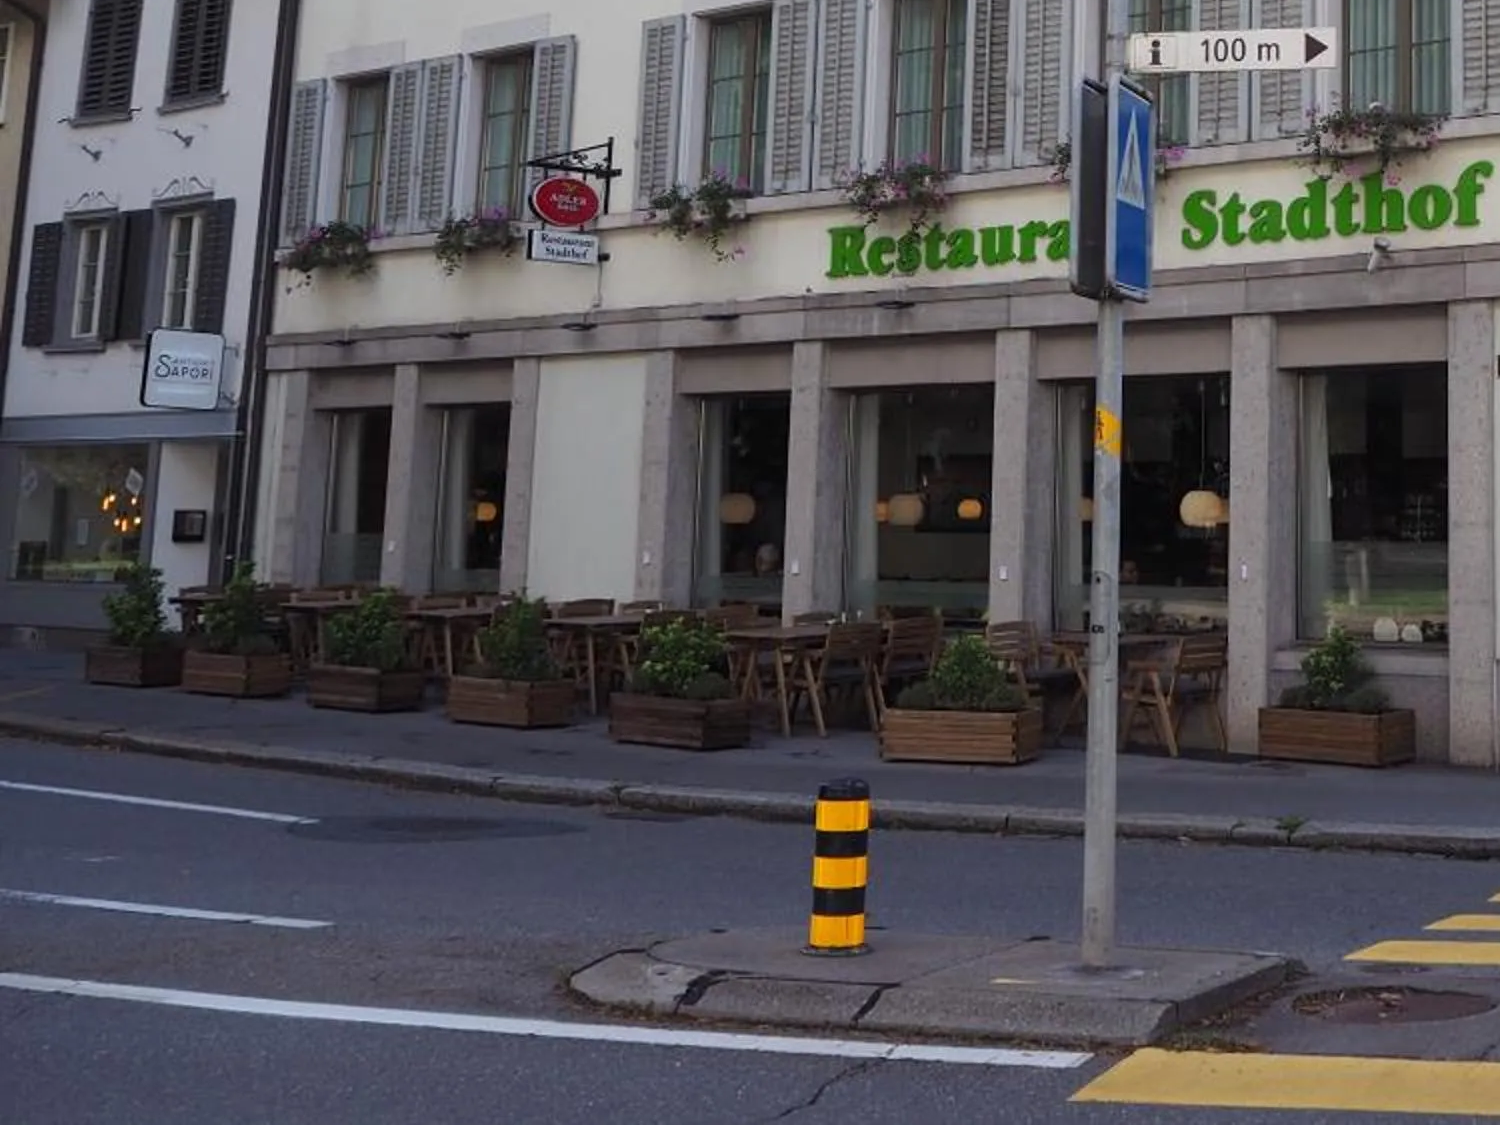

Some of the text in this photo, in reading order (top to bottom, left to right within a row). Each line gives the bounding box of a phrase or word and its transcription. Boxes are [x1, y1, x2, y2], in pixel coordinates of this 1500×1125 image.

[1200, 38, 1246, 62] 100
[1257, 42, 1280, 62] m
[1182, 160, 1493, 250] Stadthof
[826, 220, 1070, 277] Restaura
